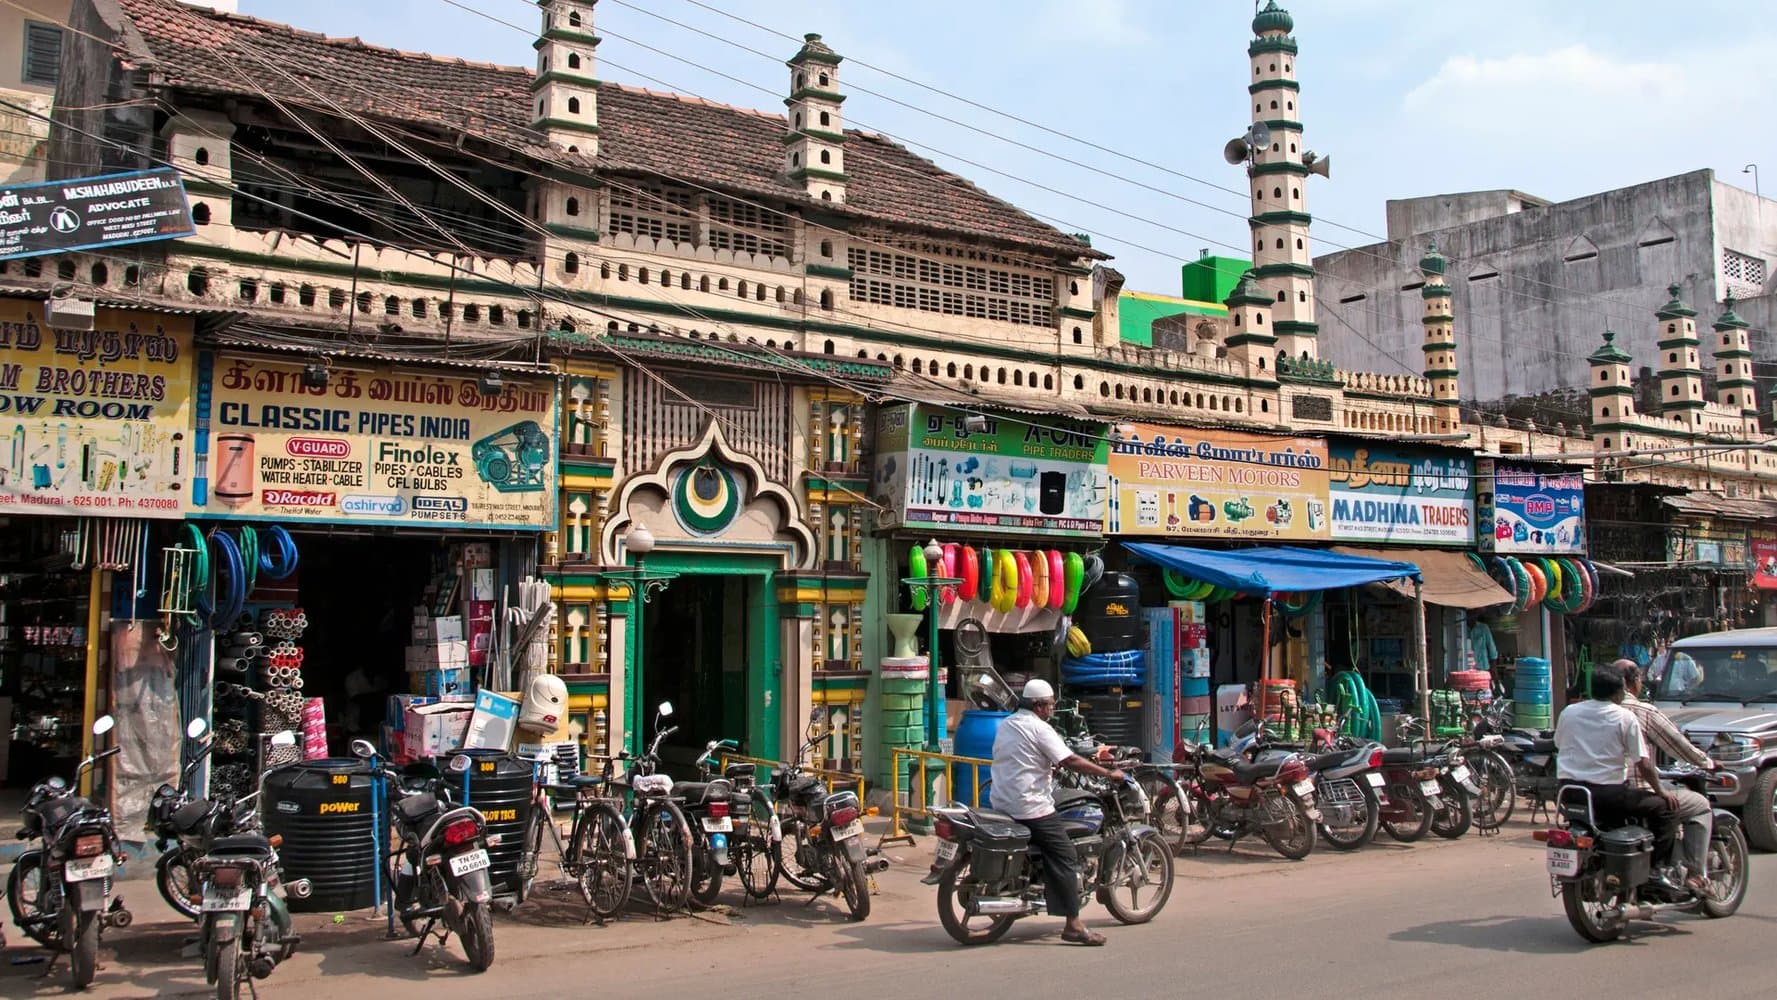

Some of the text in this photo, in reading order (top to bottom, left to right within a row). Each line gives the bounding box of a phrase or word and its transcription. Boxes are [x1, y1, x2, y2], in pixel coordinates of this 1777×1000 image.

[88, 198, 150, 213] ADVOCATE
[36, 366, 166, 401] BROTHERS
[52, 399, 153, 421] ROOM
[219, 401, 470, 440] CLASSIC PIPES INDIA
[1024, 420, 1095, 448] A-ONE
[379, 441, 460, 466] Finolex
[1024, 445, 1095, 461] PIPE TRADERS
[260, 457, 296, 471] PUMPS
[303, 459, 363, 474] STABILIZER
[374, 462, 407, 476] PIPES
[416, 465, 463, 479] CABLES
[260, 470, 291, 484] WATER
[292, 472, 328, 486] HEATER
[333, 474, 363, 487] CABLE
[1140, 462, 1300, 487] PARVEEN MOTORS
[387, 476, 448, 491] CFL BULBS
[20, 494, 64, 506] Madurai
[73, 495, 92, 507] 625
[138, 499, 179, 510] 4370080
[280, 491, 334, 505] Racold
[344, 499, 402, 512] ashirvad
[418, 499, 461, 511] IDEAL
[1332, 499, 1469, 527] MADHINA TRADERS
[481, 763, 495, 771] 500
[333, 775, 348, 785] 500
[320, 802, 360, 815] power
[501, 809, 516, 820] TECH
[470, 853, 480, 862] 59
[457, 865, 469, 873] AQ
